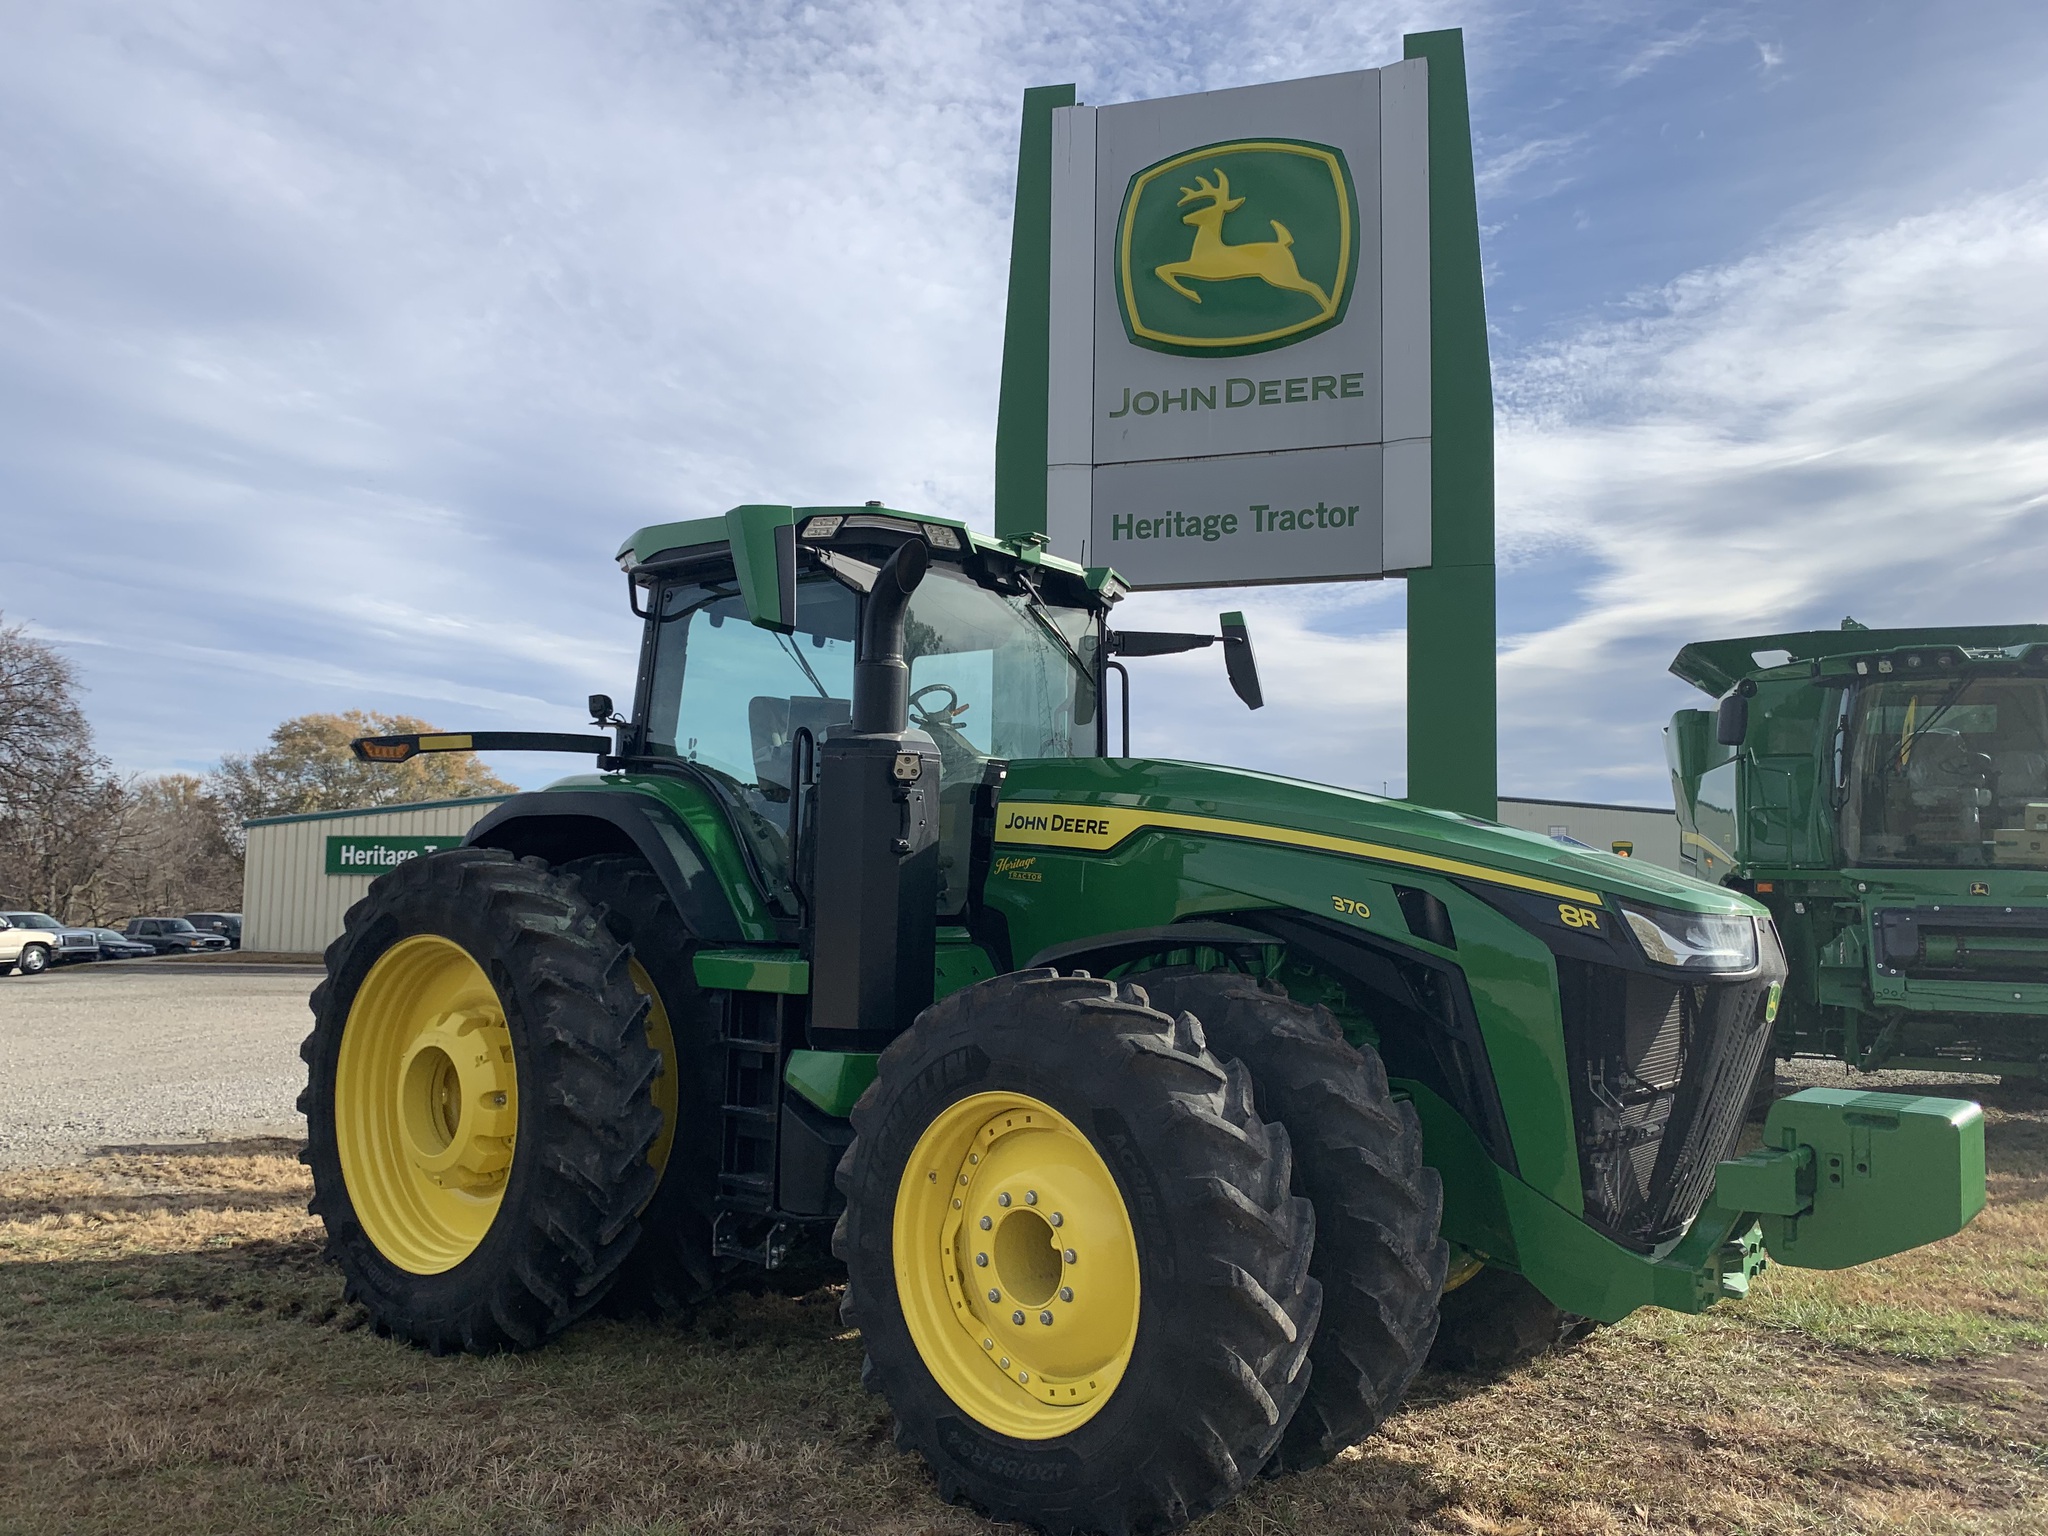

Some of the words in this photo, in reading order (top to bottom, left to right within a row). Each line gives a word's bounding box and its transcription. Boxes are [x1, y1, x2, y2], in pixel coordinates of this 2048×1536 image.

[1109, 386, 1217, 418] JOHN
[1225, 372, 1364, 409] DEERE
[1112, 510, 1238, 542] Heritage
[1249, 501, 1360, 532] Tractor
[1005, 812, 1048, 832] JOHN
[1051, 814, 1110, 835] DEERE
[993, 856, 1036, 875] Heritage
[1331, 895, 1371, 919] 370
[1558, 904, 1601, 930] 8R
